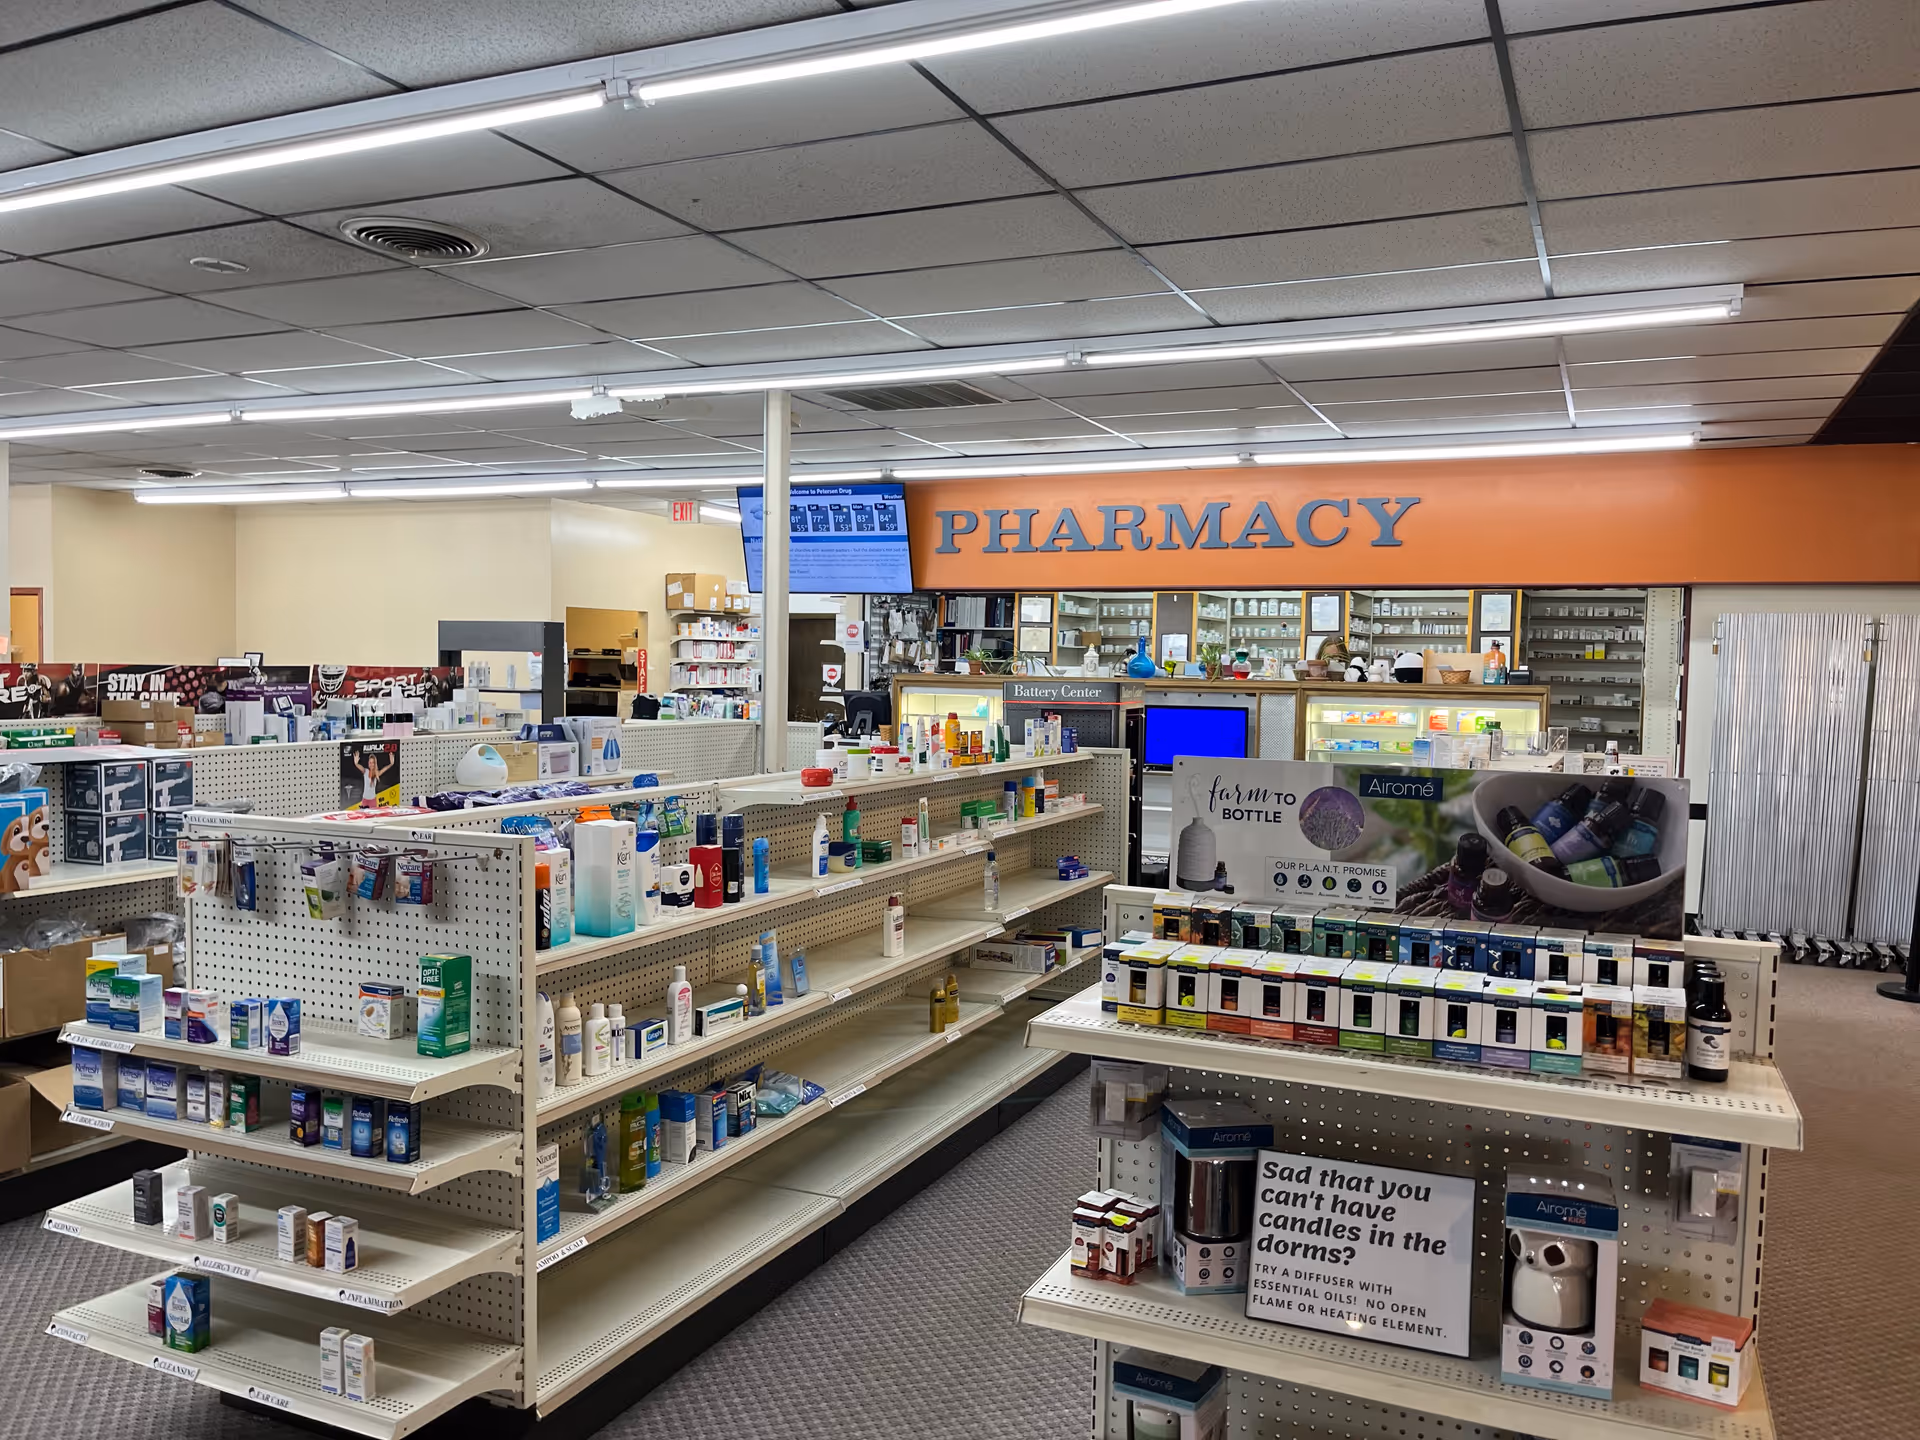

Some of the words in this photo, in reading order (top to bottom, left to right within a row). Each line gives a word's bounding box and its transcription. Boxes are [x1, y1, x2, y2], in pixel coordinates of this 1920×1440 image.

[673, 502, 694, 521] EXIT
[935, 497, 1420, 554] PHARMACY
[107, 672, 146, 692] STAY
[150, 674, 166, 692] IN
[355, 674, 418, 694] SPORT
[378, 684, 426, 698] CRE
[1014, 684, 1058, 700] Battery
[1061, 685, 1102, 698] Center
[1208, 774, 1273, 812] farm
[1274, 793, 1296, 806] TO
[1368, 777, 1434, 797] Airomé
[1222, 808, 1282, 823] BOTTLE
[354, 854, 378, 868] Nexcare
[398, 862, 420, 872] Nexcare
[1275, 861, 1296, 870] OUR
[1298, 863, 1340, 874] P.L.A.N.T.
[1342, 866, 1386, 878] PROMISE
[422, 968, 440, 976] OPTI-
[422, 976, 440, 984] FREE
[89, 979, 112, 989] Refres
[75, 1063, 100, 1074] Refresh
[120, 1065, 141, 1078] Refresh
[150, 1076, 174, 1088] Refresh
[739, 1090, 751, 1103] Nix
[72, 1114, 114, 1128] LUBRICATION
[352, 1110, 372, 1118] Refresh
[388, 1115, 408, 1123] Refresh
[1212, 1132, 1252, 1143] Airomé
[1262, 1160, 1312, 1184] Sad
[1319, 1168, 1374, 1194] that
[1377, 1180, 1432, 1202] you
[1260, 1188, 1325, 1210] can't
[1330, 1194, 1396, 1222] have
[1536, 1200, 1588, 1219] Airomé
[52, 1221, 80, 1234] REDNESS
[1568, 1216, 1586, 1225] KIDS
[1258, 1211, 1362, 1242] candles
[1369, 1224, 1395, 1248] in
[1402, 1232, 1447, 1256] the
[536, 1253, 560, 1270] AMPOO
[566, 1239, 584, 1254] SCALP
[1256, 1234, 1356, 1266] dorms?
[1254, 1262, 1278, 1275] TRY
[1282, 1268, 1290, 1277] A
[1294, 1270, 1354, 1289] DIFFUSER
[1359, 1281, 1392, 1296] WITH
[346, 1293, 404, 1309] INFLAMMATION
[1254, 1278, 1319, 1299] ESSENTIAL
[1324, 1290, 1357, 1306] OILS!
[1366, 1298, 1386, 1310] NO
[1390, 1302, 1426, 1318] OPEN
[1252, 1294, 1293, 1310] FLAME
[1297, 1302, 1315, 1314] OR
[1320, 1306, 1377, 1326] HEATING
[1382, 1318, 1448, 1339] ELEMENT.
[56, 1327, 87, 1342] CONTACTS
[159, 1361, 196, 1378] CLEANSING
[256, 1391, 270, 1402] EAR
[270, 1396, 290, 1408] CARE
